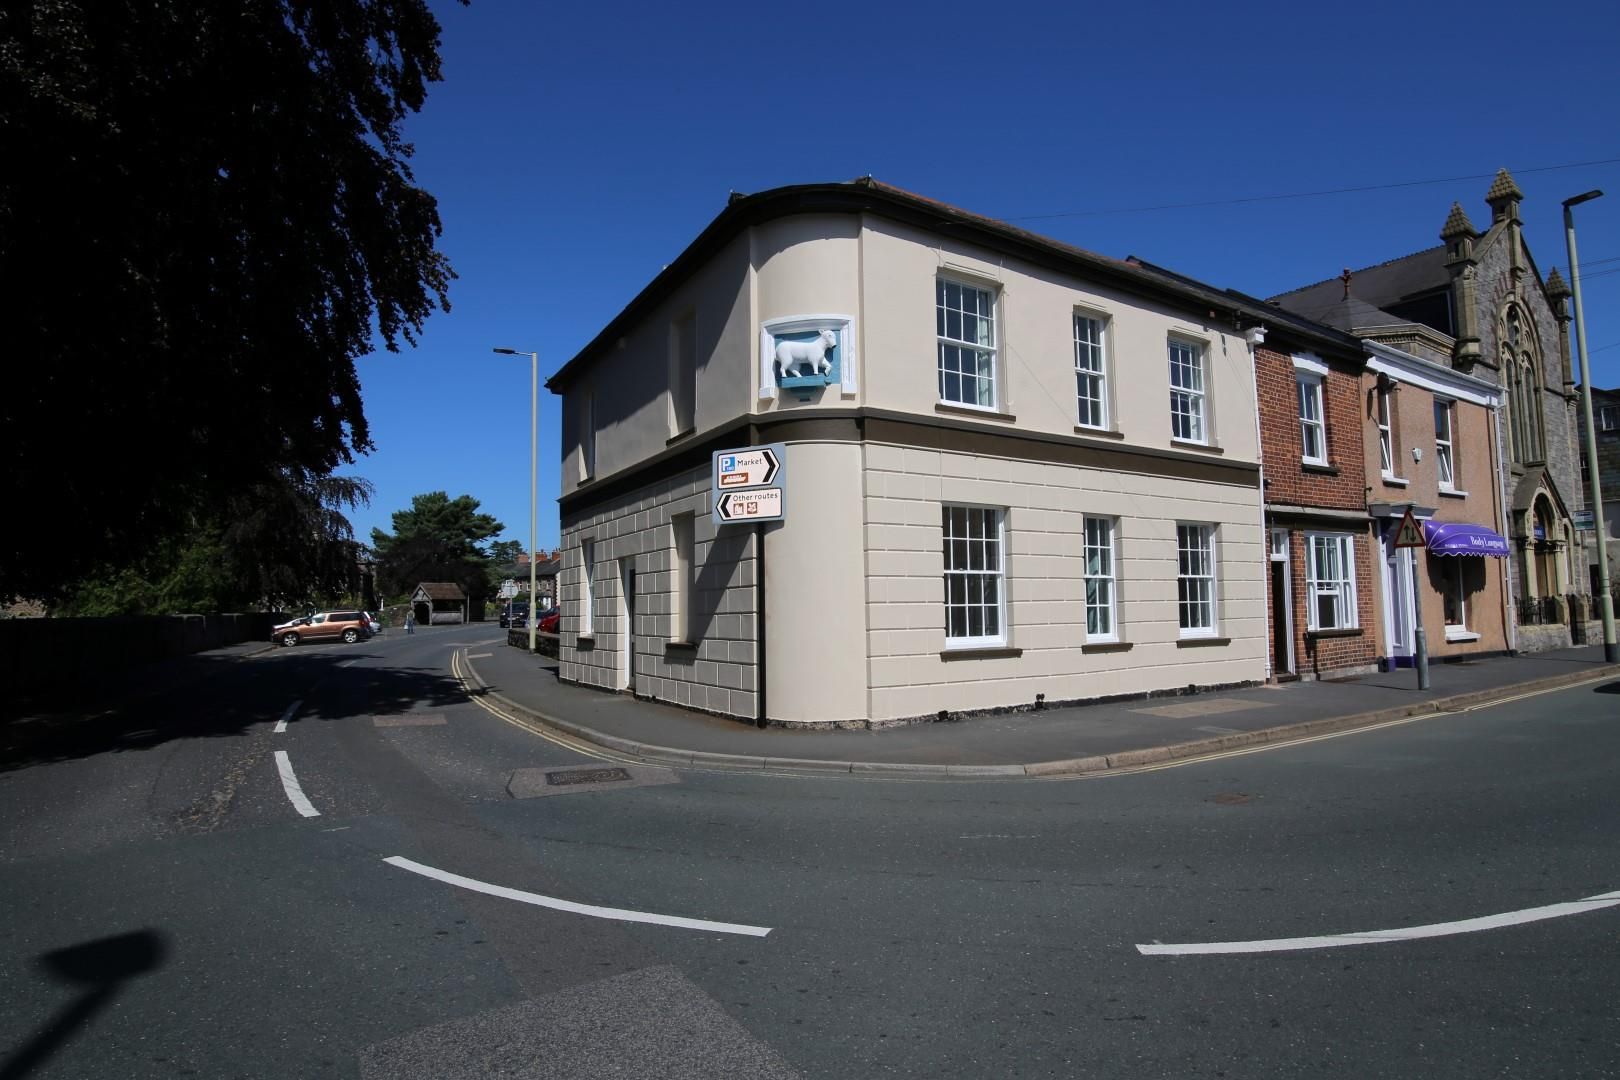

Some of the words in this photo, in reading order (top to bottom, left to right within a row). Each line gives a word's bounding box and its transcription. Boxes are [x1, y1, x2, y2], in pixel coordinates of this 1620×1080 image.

[722, 458, 731, 471] P
[737, 458, 762, 466] Market
[733, 494, 753, 502] Other
[1470, 535, 1485, 548] Body
